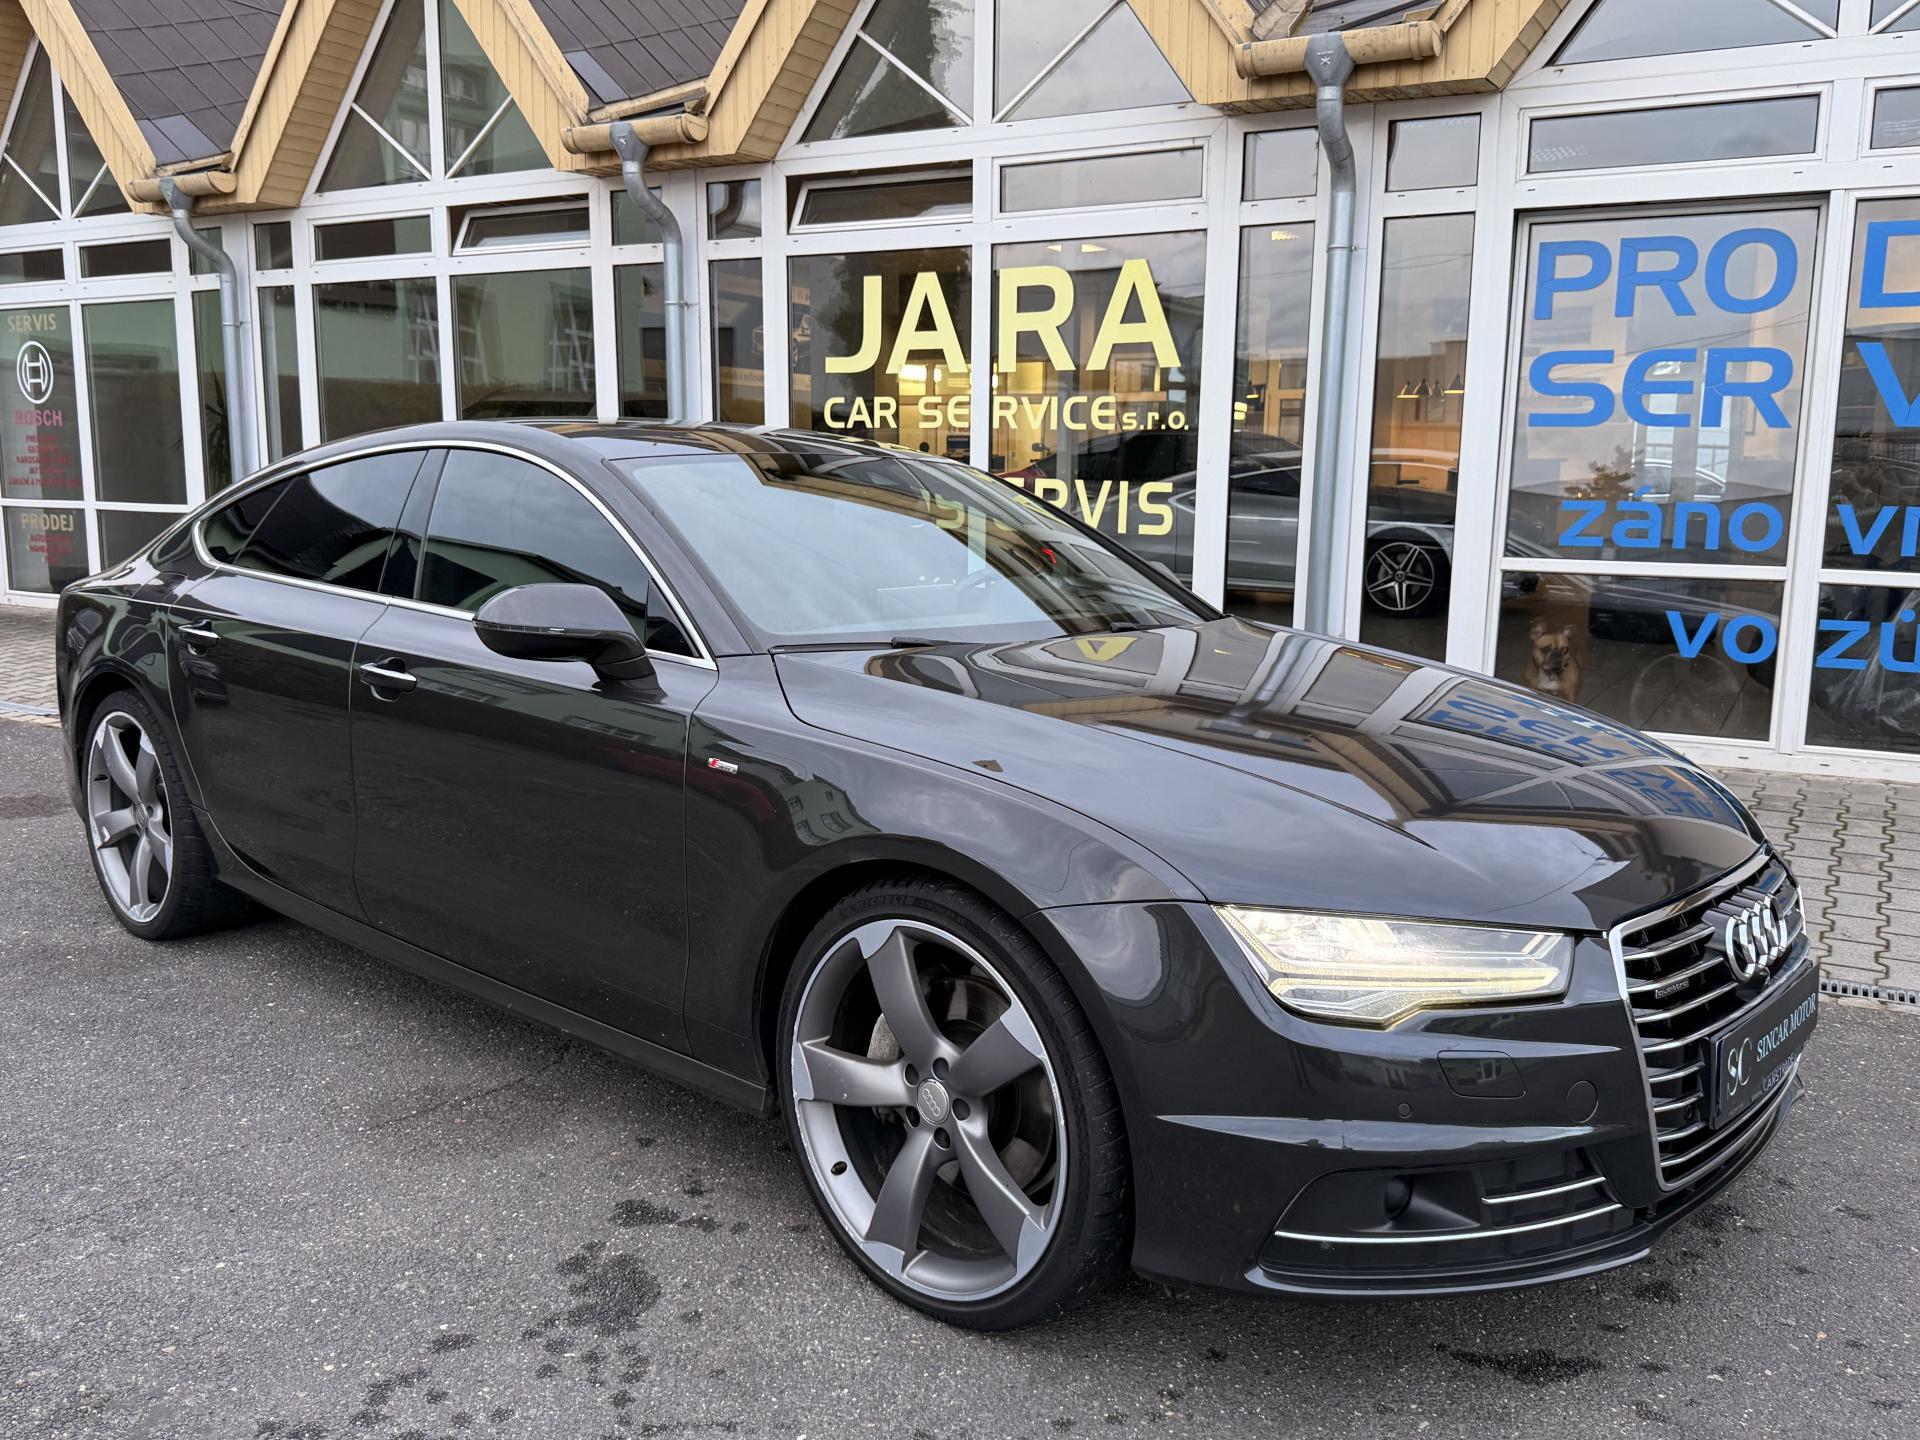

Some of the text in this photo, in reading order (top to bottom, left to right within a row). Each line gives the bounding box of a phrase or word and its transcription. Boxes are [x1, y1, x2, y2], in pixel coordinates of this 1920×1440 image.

[8, 313, 57, 333] SERVIS
[825, 258, 1181, 374] JARA
[15, 408, 64, 427] BOSCH
[824, 396, 897, 429] CAR
[21, 512, 75, 532] PRODEJ
[1757, 992, 1816, 1062] SINCAR MOTOR
